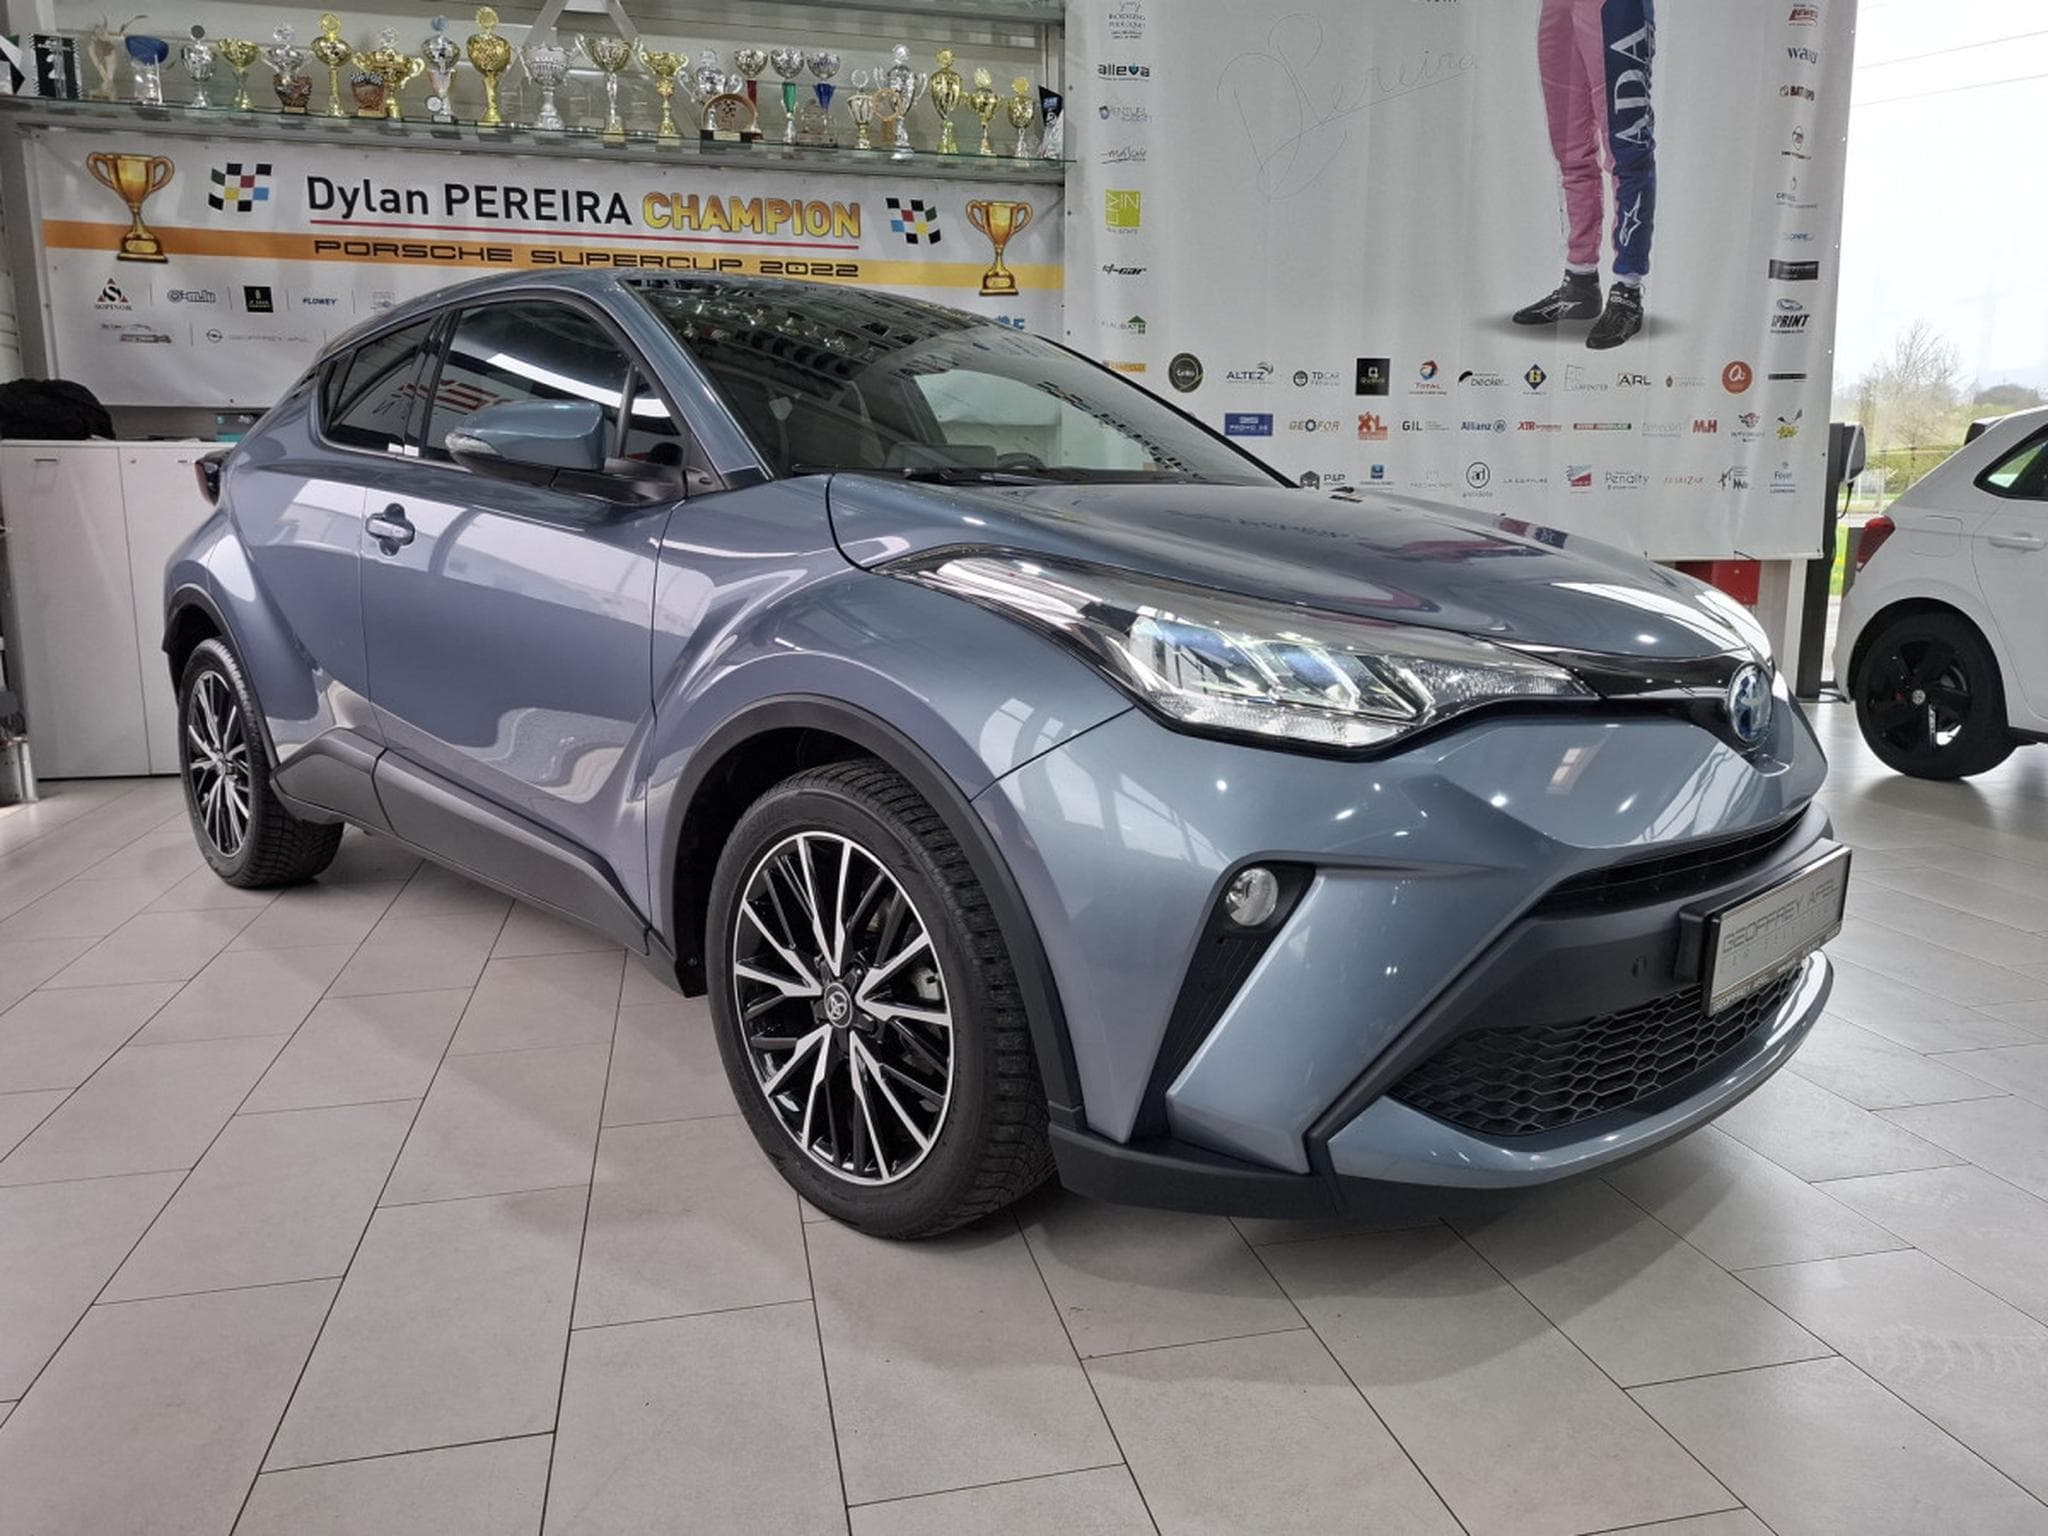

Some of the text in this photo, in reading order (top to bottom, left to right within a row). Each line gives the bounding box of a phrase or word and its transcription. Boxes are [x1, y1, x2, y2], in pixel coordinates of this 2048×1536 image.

[307, 176, 861, 239] Dylan PEREIRA CHAMPION
[314, 240, 859, 277] PORSCHE SUPERCUP 2022
[1226, 371, 1266, 380] ALTEZ
[1619, 374, 1652, 386] ARL
[1289, 419, 1340, 432] GEOFOR
[1402, 420, 1423, 431] GIL
[1461, 421, 1492, 431] Allianz
[1324, 473, 1346, 482] P&P
